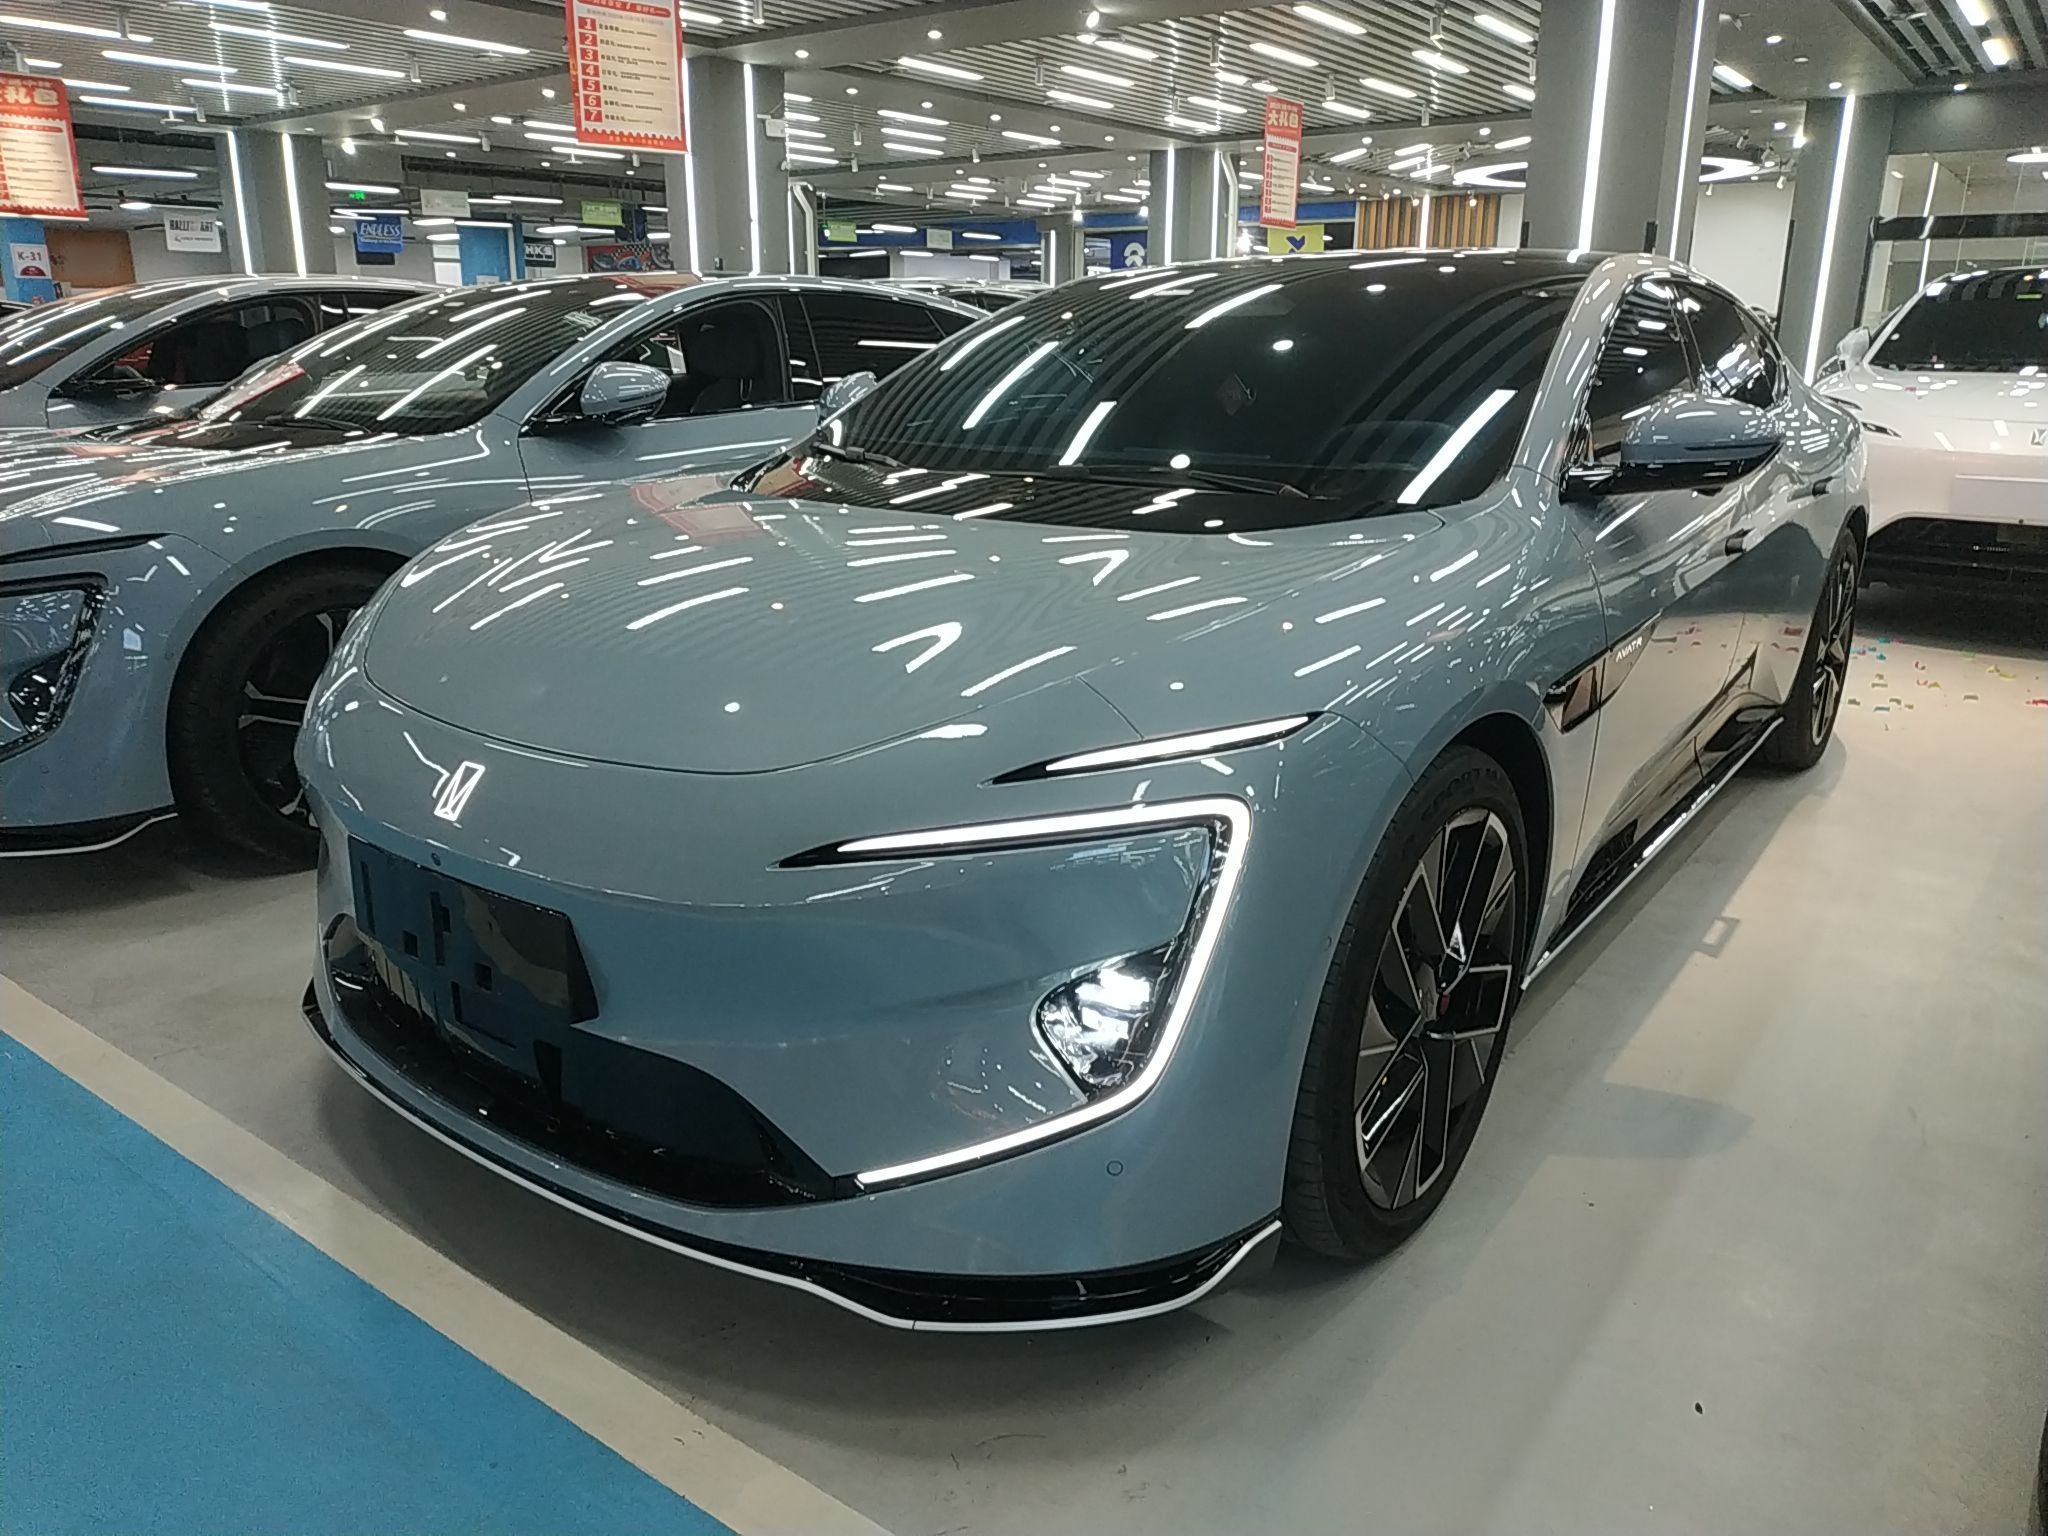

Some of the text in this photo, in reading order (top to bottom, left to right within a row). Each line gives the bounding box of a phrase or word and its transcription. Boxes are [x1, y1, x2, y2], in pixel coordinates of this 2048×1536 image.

[584, 18, 593, 30] 1
[584, 34, 593, 46] 2
[584, 49, 594, 60] 3
[585, 64, 594, 76] 4
[586, 80, 596, 91] 5
[588, 96, 597, 106] 6
[589, 110, 598, 121] 7
[1267, 109, 1299, 129] 大礼包
[360, 222, 401, 237] ENDLESS
[17, 251, 42, 261] K-31
